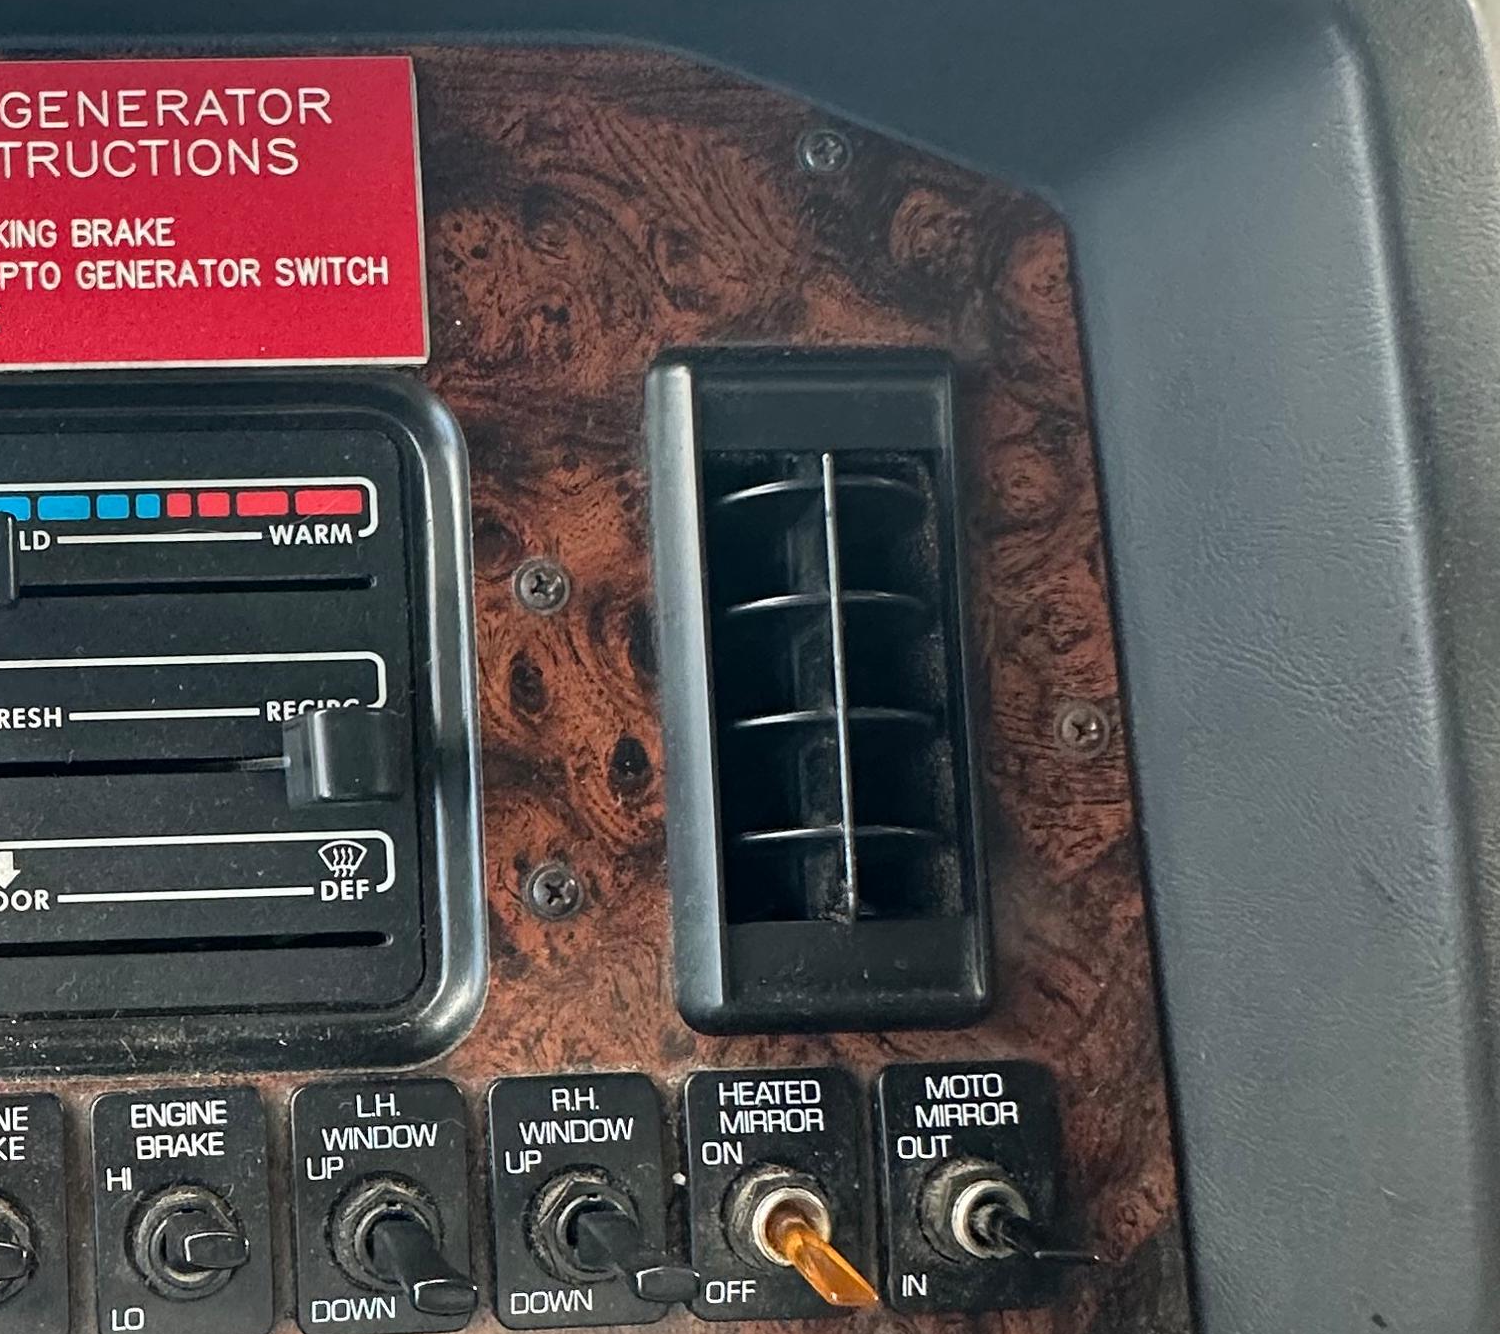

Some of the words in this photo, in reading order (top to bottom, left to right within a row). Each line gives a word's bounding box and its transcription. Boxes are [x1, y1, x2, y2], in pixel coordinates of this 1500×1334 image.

[0, 88, 331, 128] GENERATOR
[71, 217, 175, 247] BRAKE
[0, 261, 60, 290] PTO
[76, 258, 260, 289] GENERATOR
[276, 257, 388, 286] SWITCH
[269, 524, 352, 545] WARM
[321, 879, 369, 901] DEF
[719, 1080, 820, 1106] HEATED
[926, 1074, 1003, 1099] MOTO
[357, 1094, 400, 1117] L.H.
[552, 1088, 599, 1111] R.H.
[131, 1100, 227, 1128] ENGINE
[720, 1109, 824, 1133] MIRROR
[916, 1102, 1018, 1127] MIRROR
[322, 1124, 437, 1151] WINDOW
[519, 1118, 633, 1144] WINDOW
[136, 1132, 224, 1159] BRAKE
[702, 1142, 743, 1165] ON
[898, 1135, 952, 1159] OUT
[307, 1157, 343, 1180] UP
[506, 1150, 541, 1173] UP
[107, 1167, 131, 1191] HI
[706, 1280, 756, 1303] OFF
[903, 1274, 926, 1296] IN
[312, 1297, 395, 1322] DOWN
[511, 1289, 592, 1314] DOWN
[112, 1308, 144, 1331] LO
